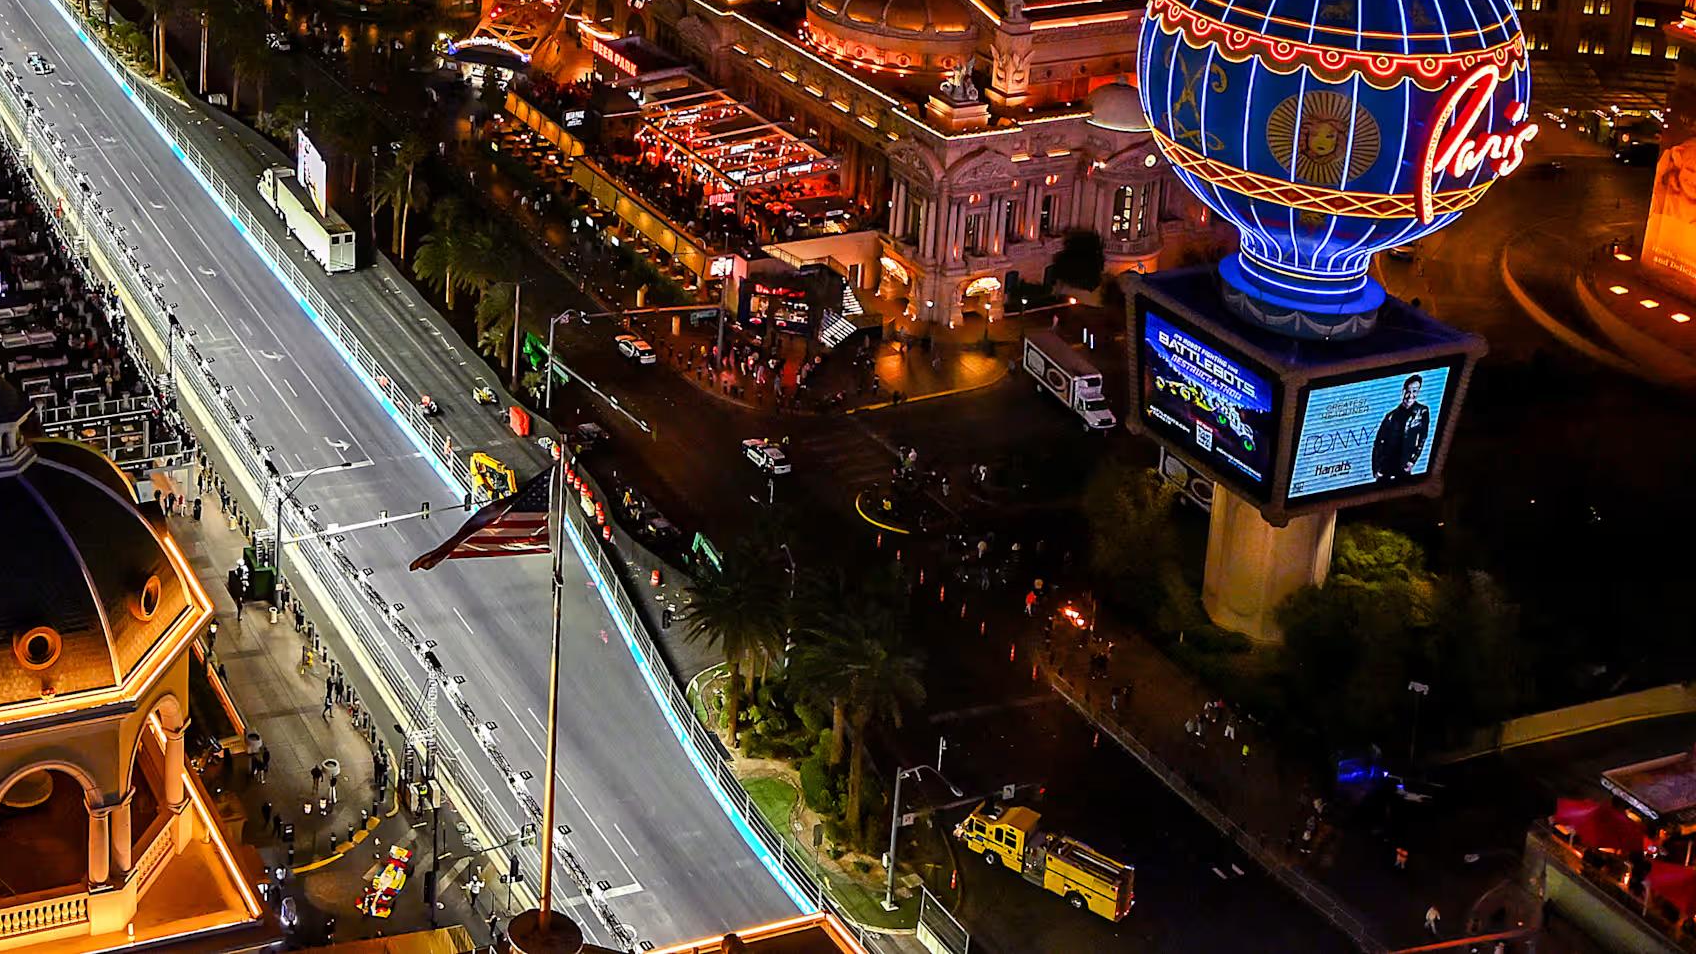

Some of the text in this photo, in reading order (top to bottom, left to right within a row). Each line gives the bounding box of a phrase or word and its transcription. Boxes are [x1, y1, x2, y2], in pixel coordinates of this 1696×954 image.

[592, 39, 638, 77] BEER PARK
[1417, 63, 1539, 225] Paris
[1201, 348, 1228, 368] FIGHTING
[1304, 423, 1379, 457] DONNY
